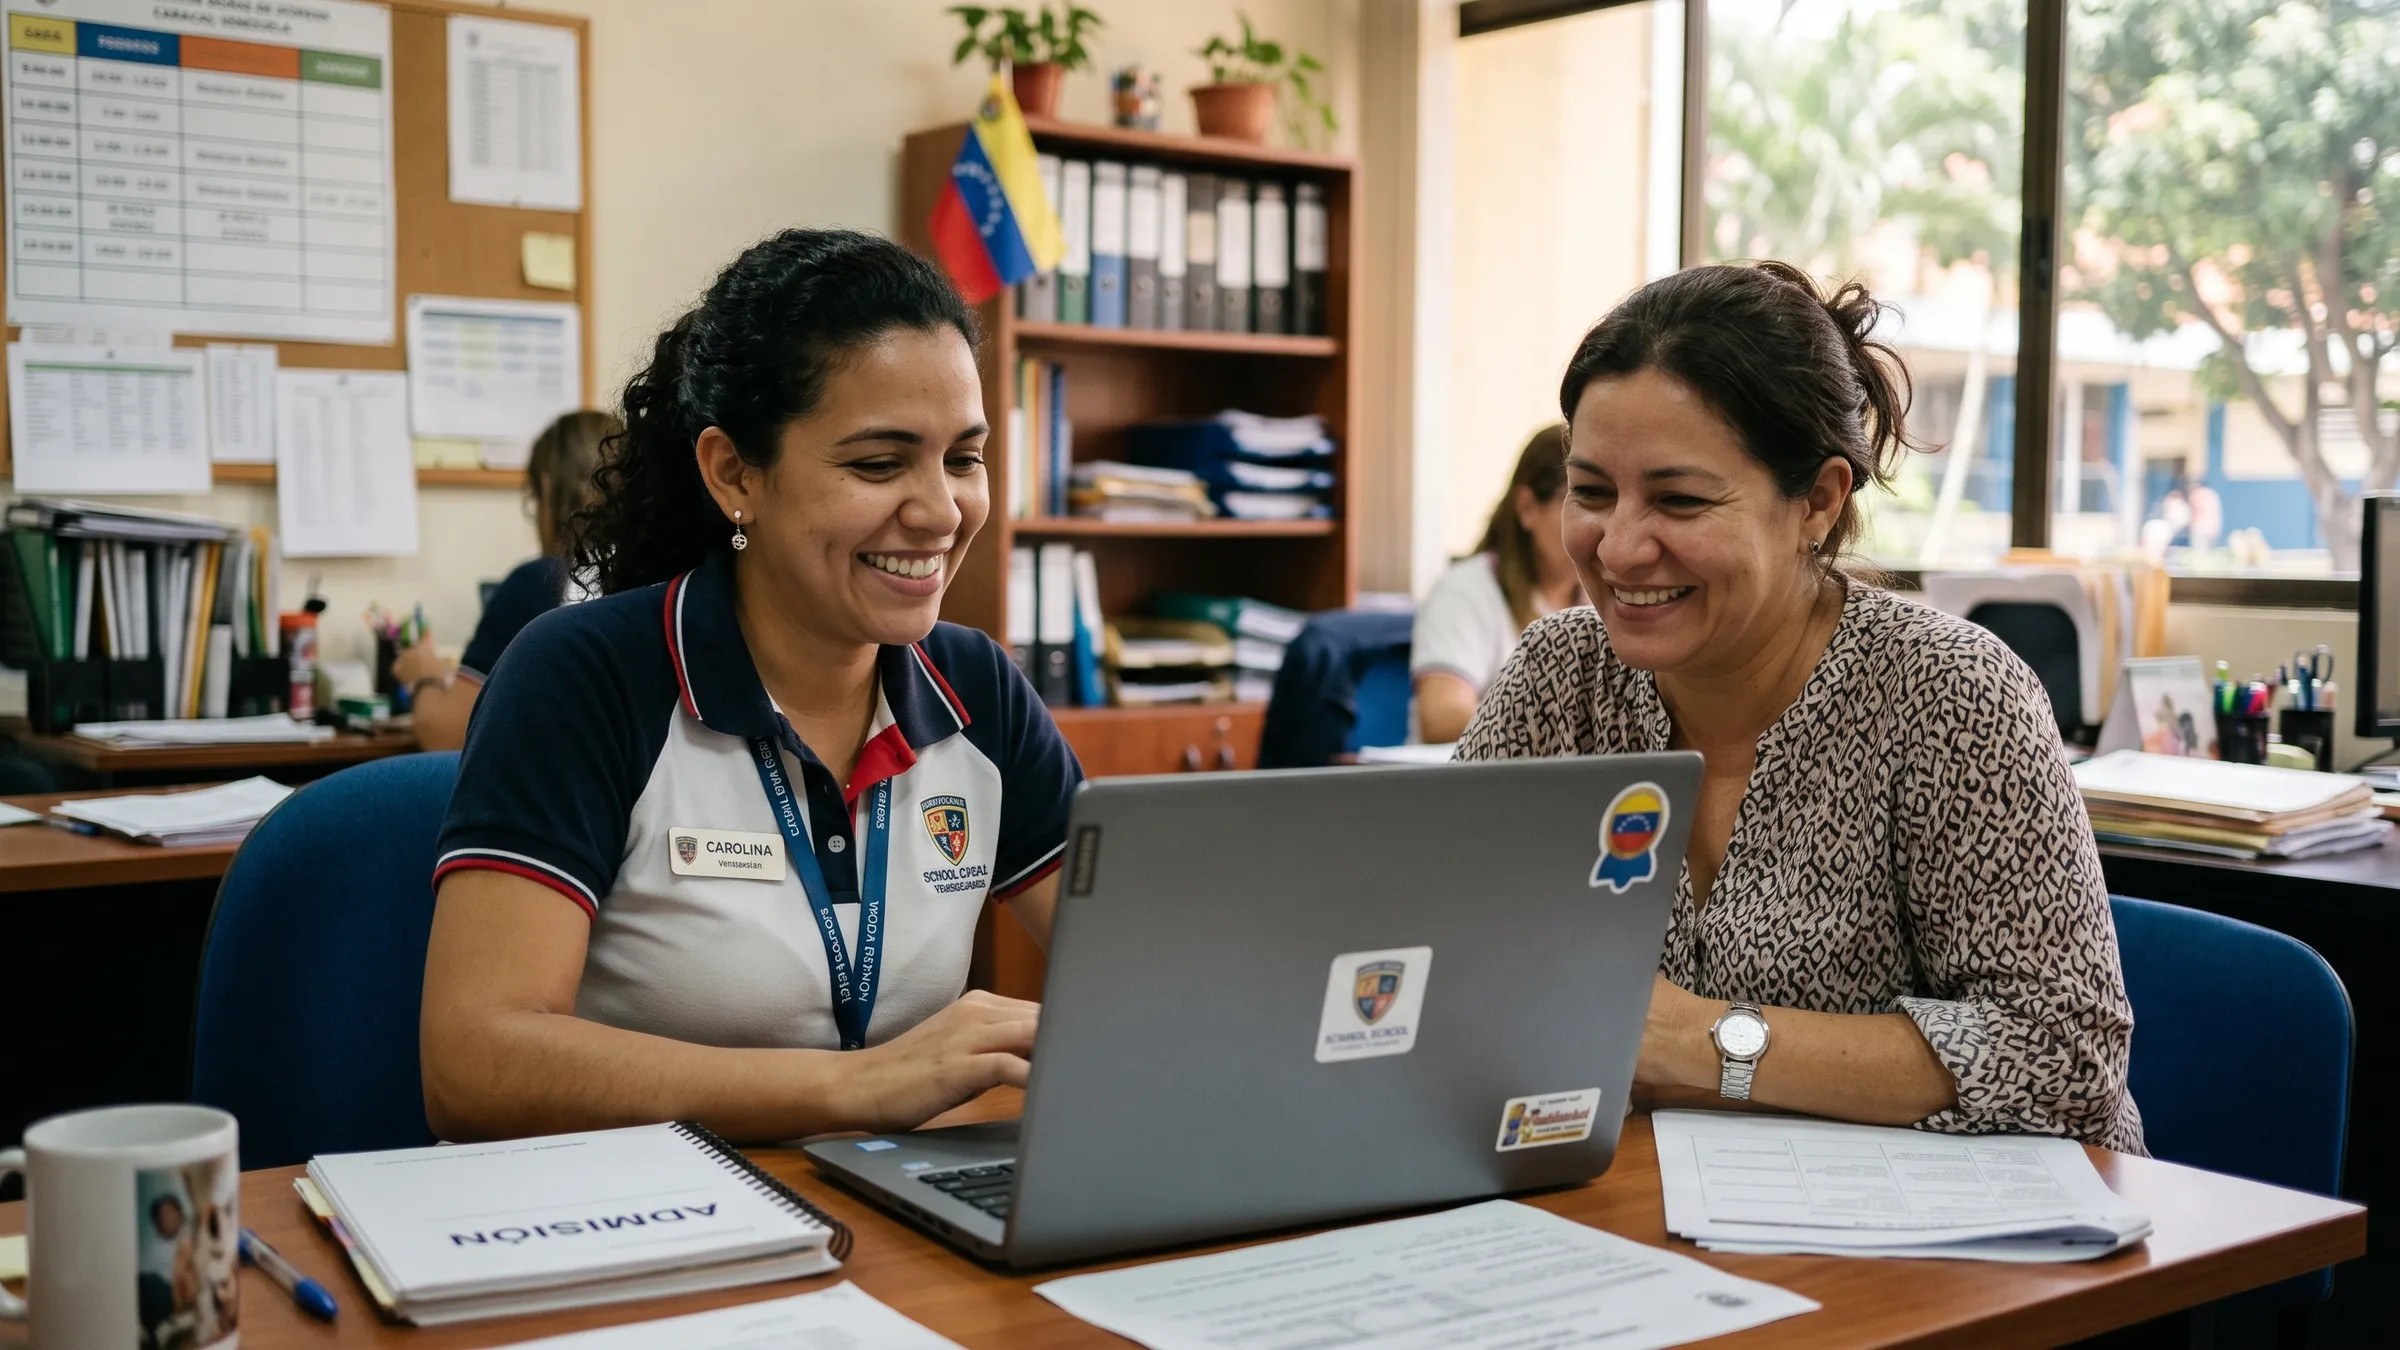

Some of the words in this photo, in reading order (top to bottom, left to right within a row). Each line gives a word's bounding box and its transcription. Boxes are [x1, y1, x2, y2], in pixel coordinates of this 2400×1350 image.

[706, 841, 773, 857] CAROLINA
[923, 868, 960, 883] SCHOOL
[449, 1202, 718, 1248] ADMISIÓN
